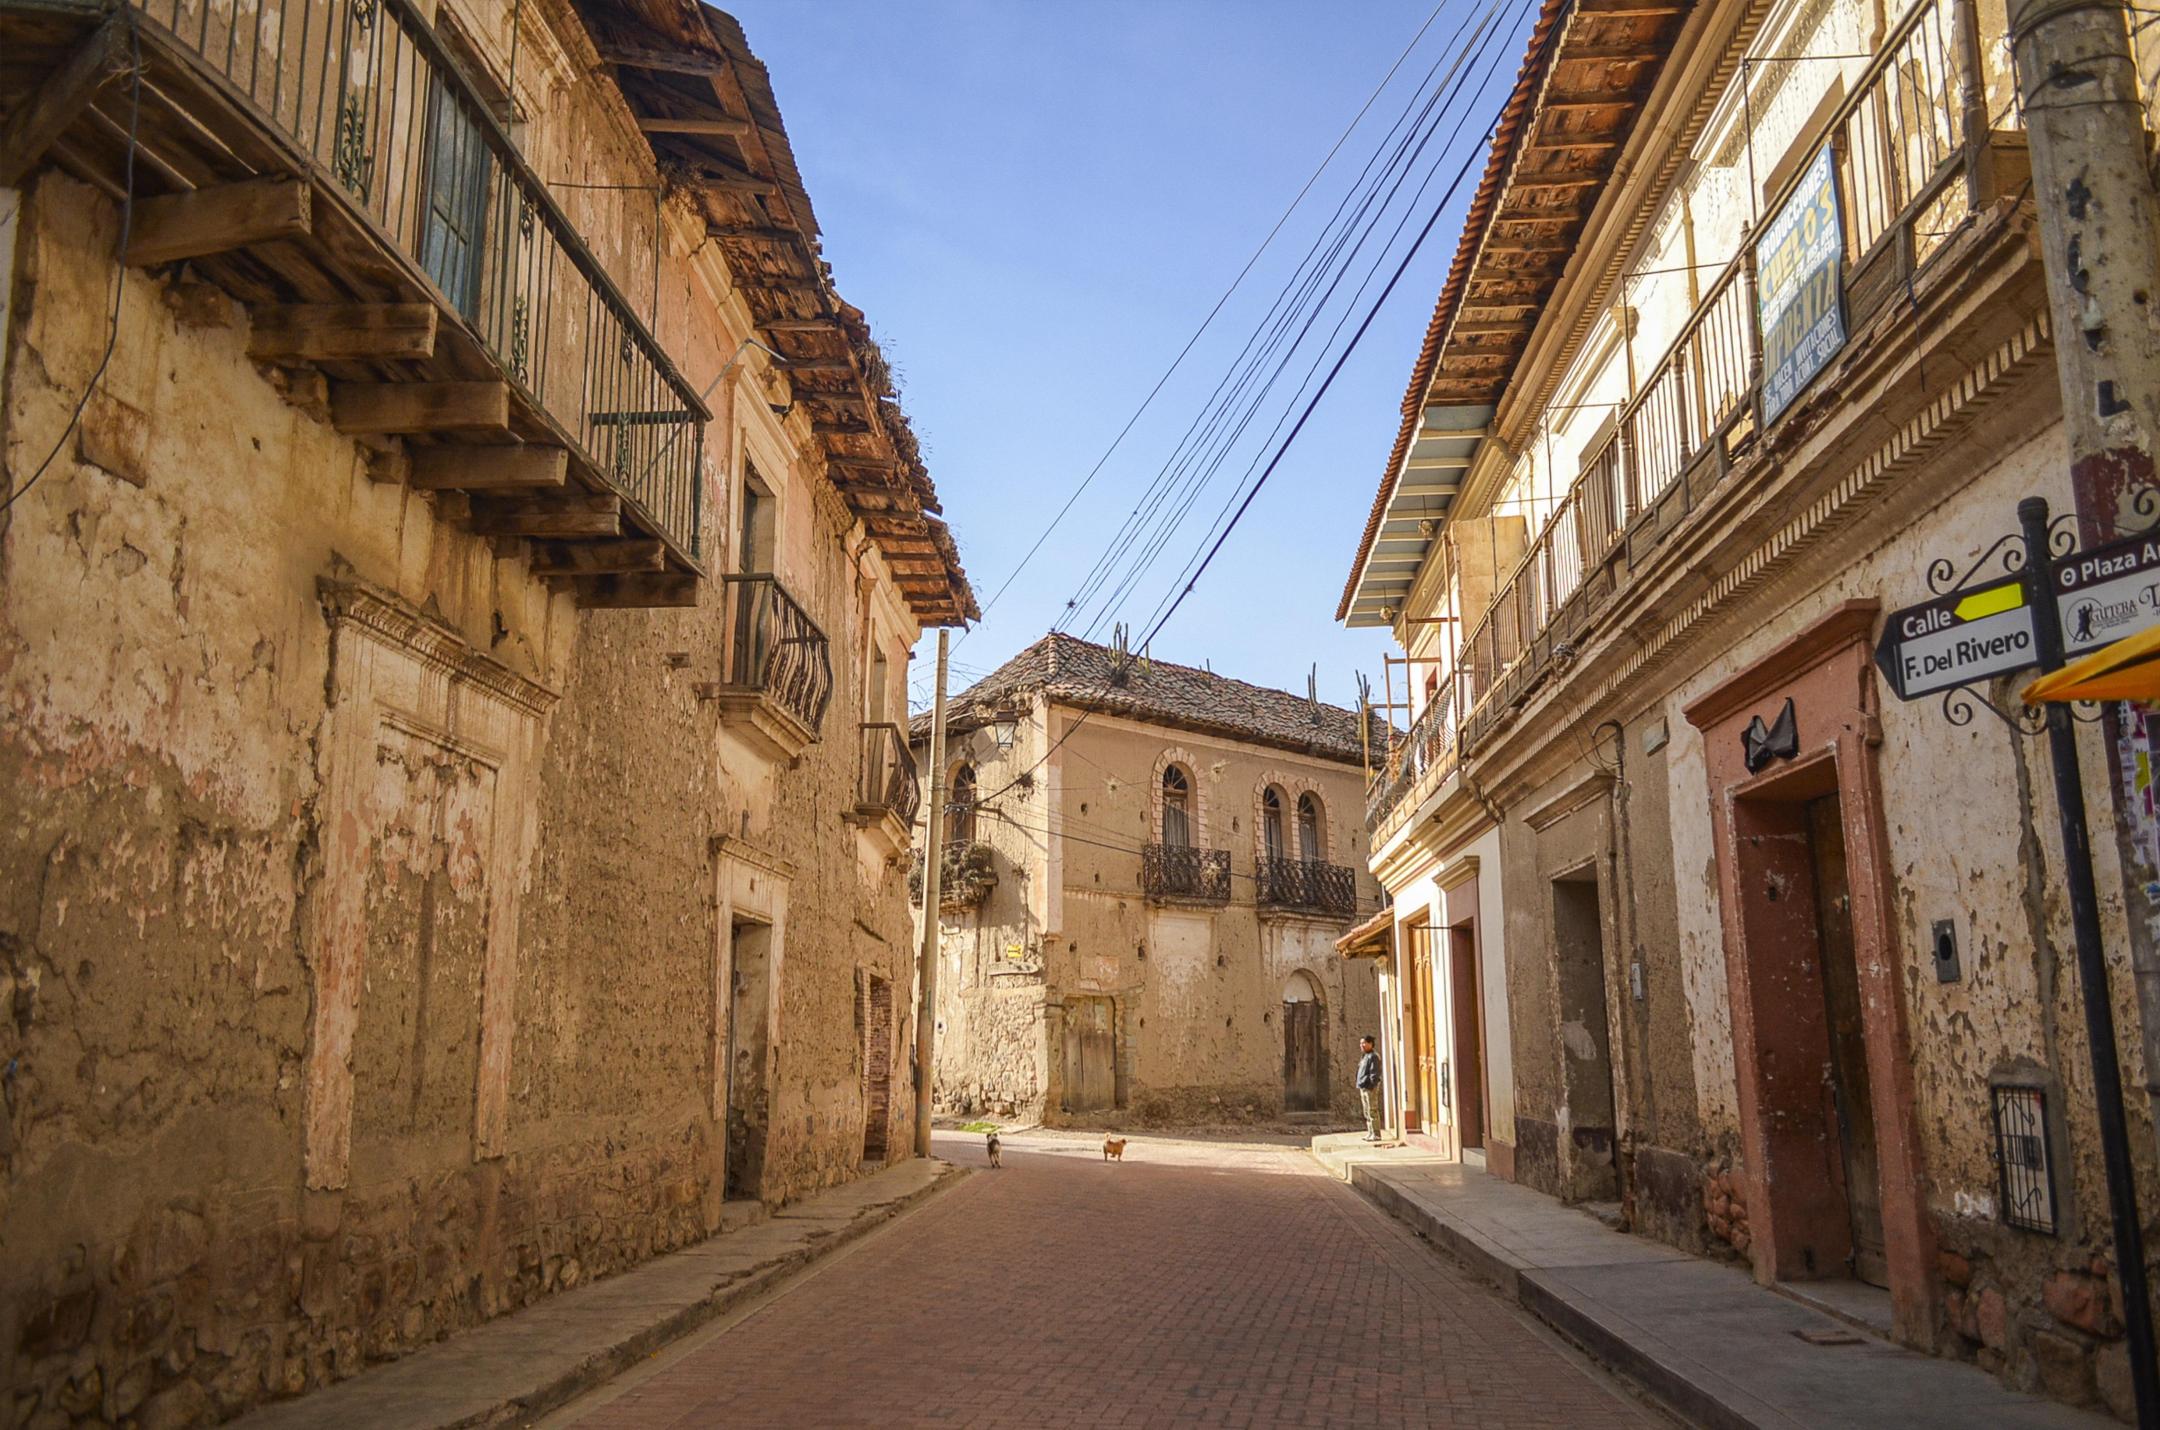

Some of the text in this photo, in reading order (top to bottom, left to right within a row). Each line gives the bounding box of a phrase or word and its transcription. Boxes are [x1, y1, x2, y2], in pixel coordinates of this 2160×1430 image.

[1758, 154, 1827, 272] PRODUCCIONES
[1761, 179, 1834, 303] CHELO'S
[2081, 543, 2160, 581] Plaza A
[1902, 608, 1951, 638] Calle
[1904, 630, 2030, 680] F. Del Rivero
